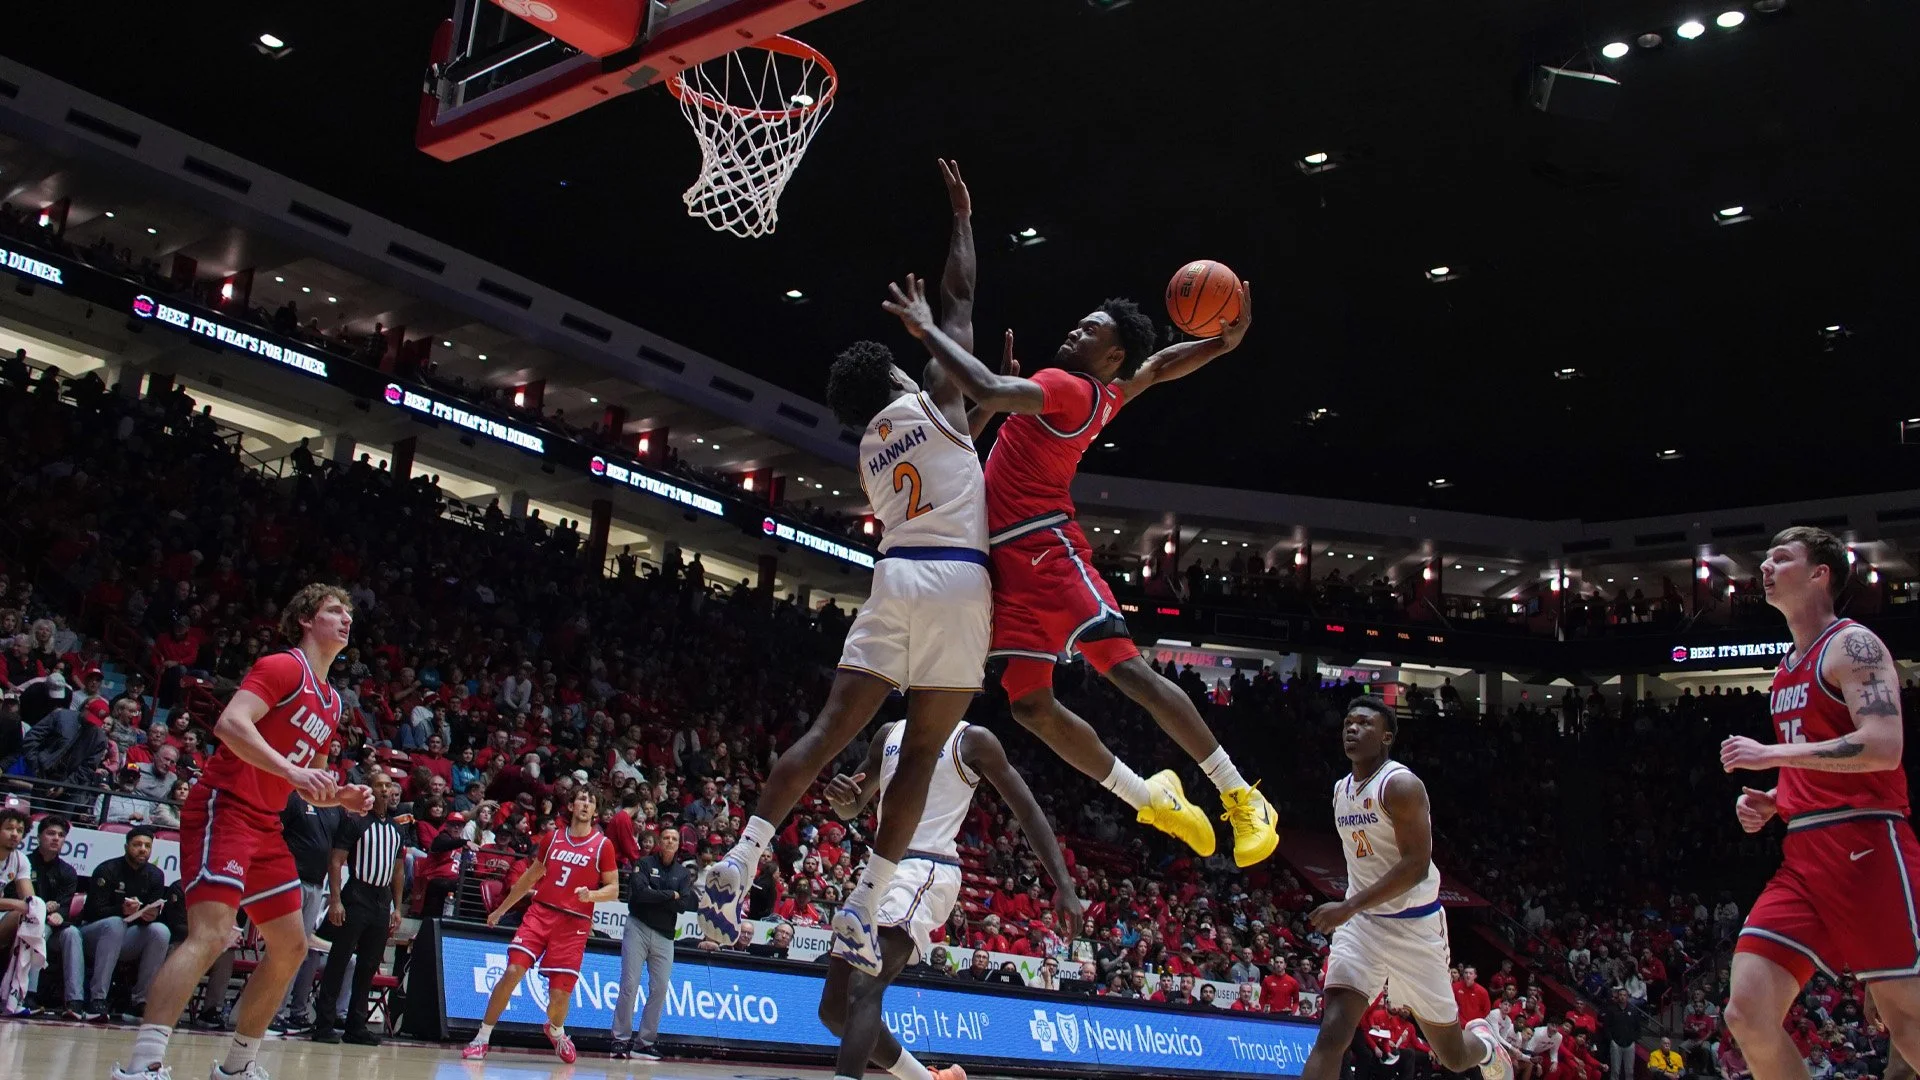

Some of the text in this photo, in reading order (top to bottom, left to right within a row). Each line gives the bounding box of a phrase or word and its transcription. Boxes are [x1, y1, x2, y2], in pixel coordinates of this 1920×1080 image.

[192, 316, 216, 337] IT'S
[216, 325, 258, 353] WHAT'S
[258, 340, 282, 361] FOR
[432, 401, 453, 421] IT'S
[453, 408, 488, 433] WHAT'S
[487, 420, 507, 439] FOR
[868, 425, 927, 476] HANNAH
[893, 461, 934, 521] 2
[1718, 645, 1738, 658] IT'S
[1738, 643, 1775, 657] WHAT'S
[1337, 813, 1379, 828] SPARTANS
[550, 848, 591, 867] LOBOS
[1351, 829, 1374, 859] 21
[555, 865, 572, 887] 3
[666, 979, 778, 1025] Mexico
[934, 1009, 952, 1038] It
[1083, 1019, 1203, 1057] New Mexico
[1227, 1035, 1293, 1070] Through
[1293, 1042, 1307, 1064] It
